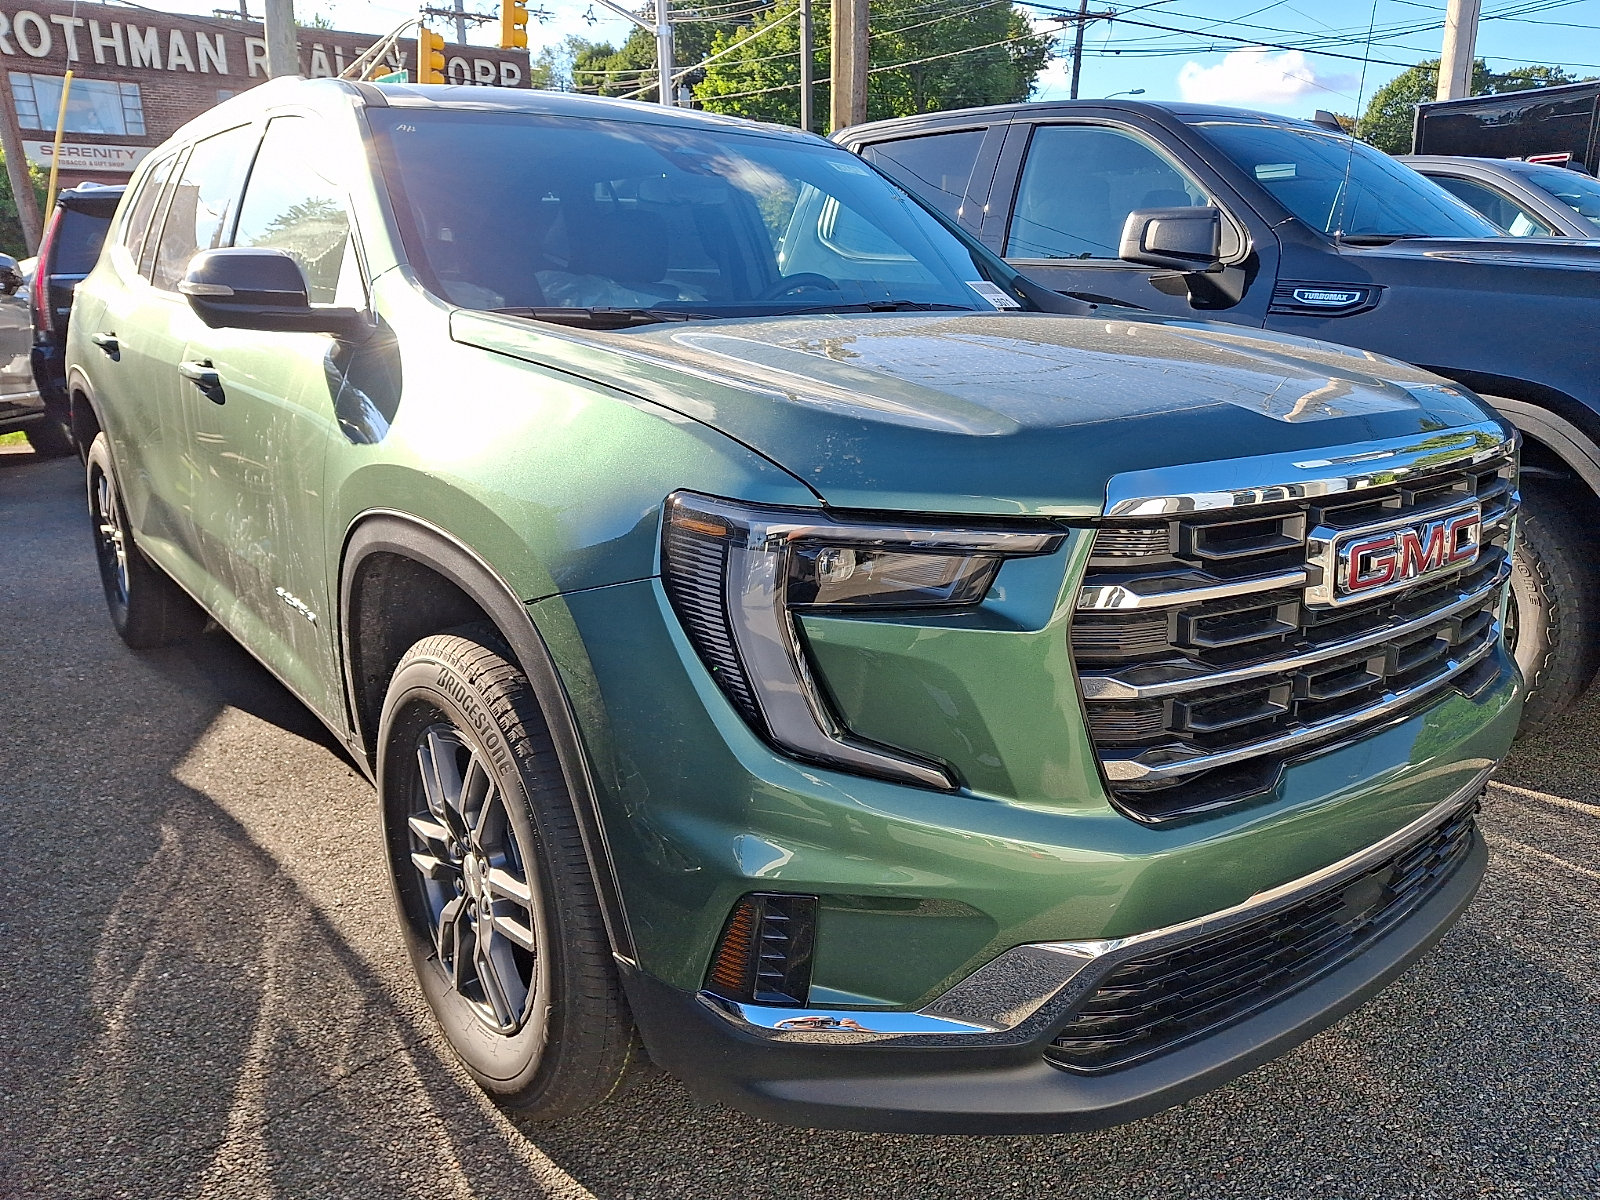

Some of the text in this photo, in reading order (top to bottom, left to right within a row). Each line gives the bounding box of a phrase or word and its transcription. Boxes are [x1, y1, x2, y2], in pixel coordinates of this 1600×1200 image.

[245, 37, 408, 80] RALTY
[447, 56, 522, 87] ORP
[40, 145, 136, 159] SERENITY
[1304, 292, 1349, 301] TURBOMAX
[1345, 511, 1481, 592] GMC
[435, 667, 515, 777] BRIDGESTONE
